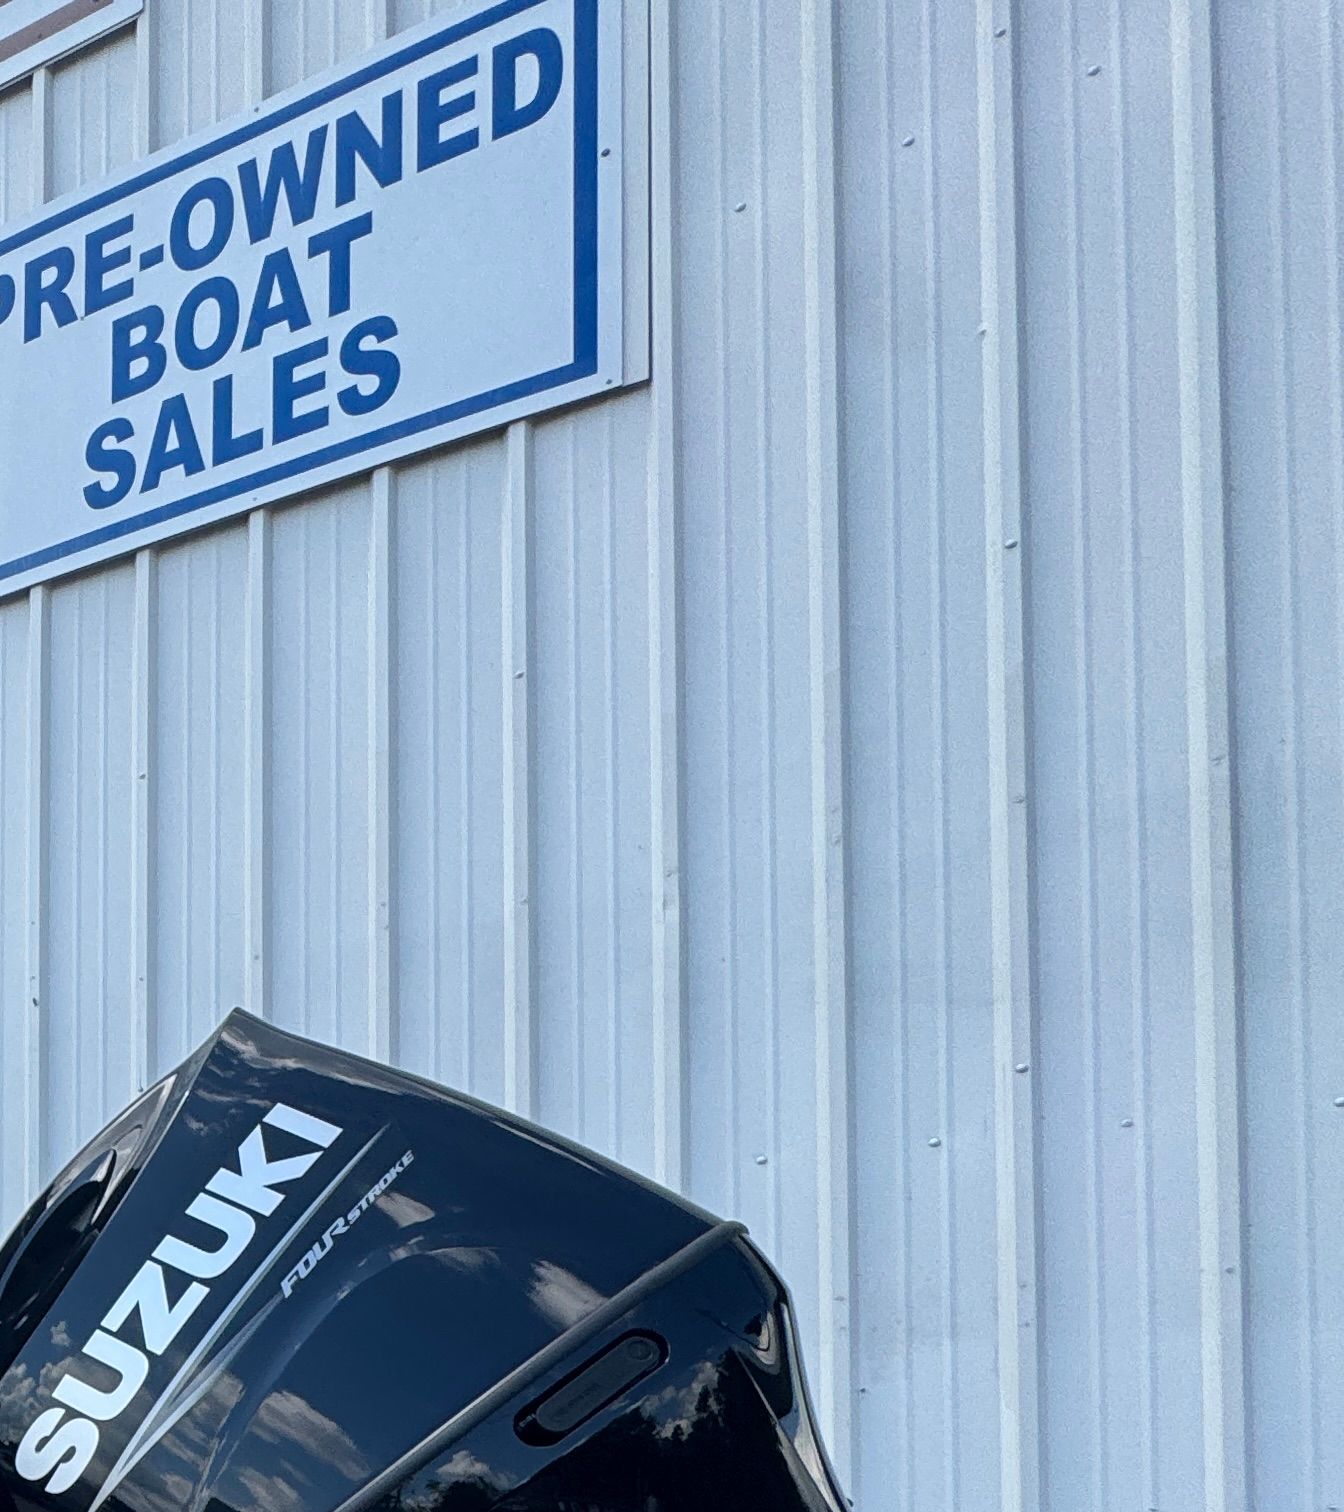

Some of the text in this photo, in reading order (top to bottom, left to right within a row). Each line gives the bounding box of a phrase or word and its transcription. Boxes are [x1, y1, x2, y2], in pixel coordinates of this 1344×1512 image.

[111, 211, 373, 404] BOAT
[82, 315, 402, 510] SALES
[14, 1102, 344, 1494] SUZUKI
[280, 1150, 415, 1298] FOUR STROKE
